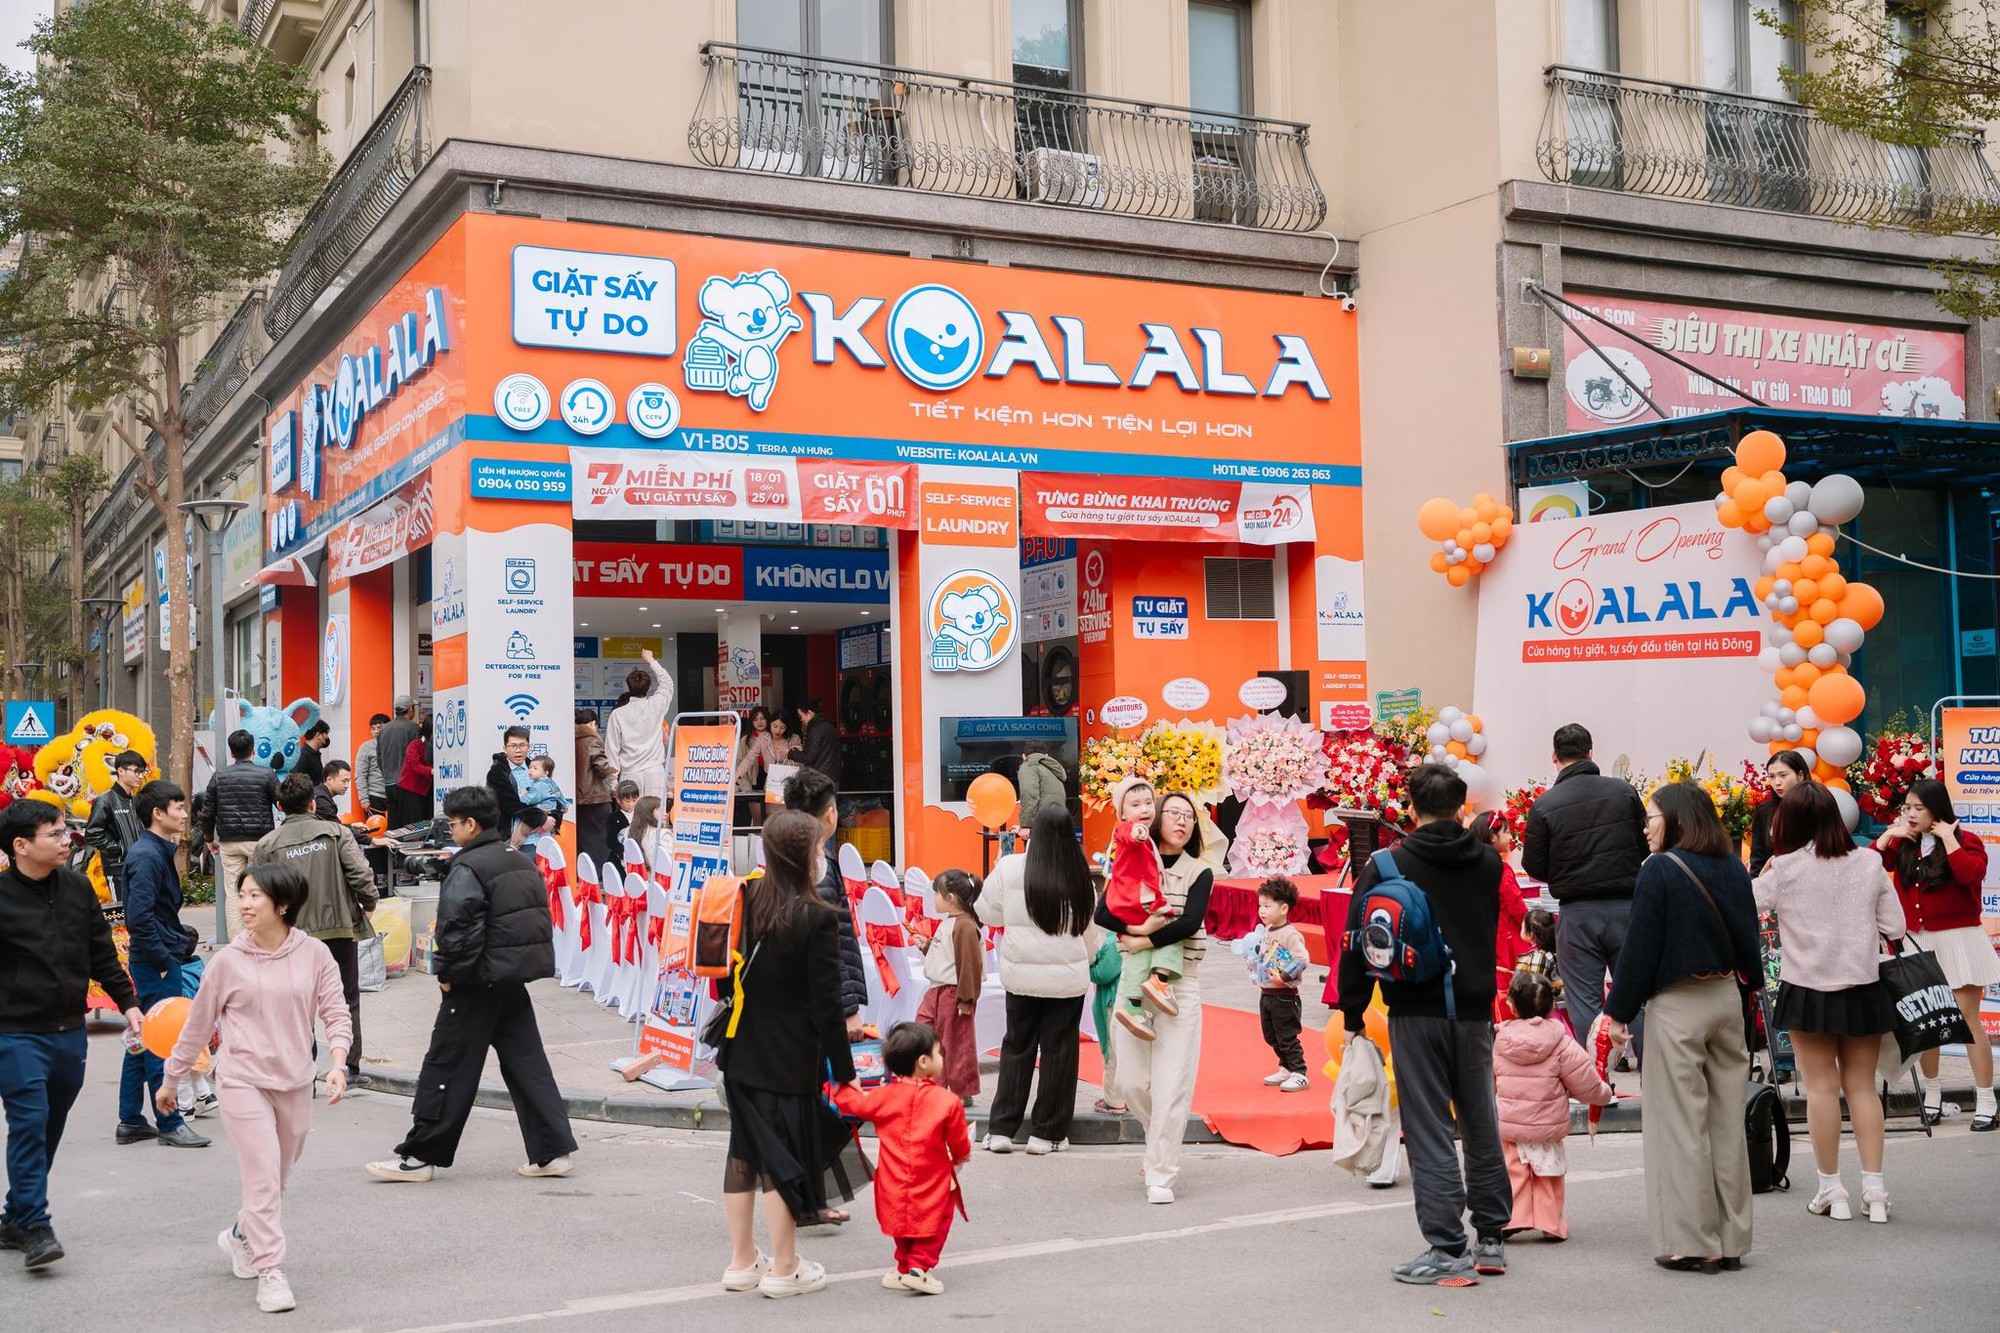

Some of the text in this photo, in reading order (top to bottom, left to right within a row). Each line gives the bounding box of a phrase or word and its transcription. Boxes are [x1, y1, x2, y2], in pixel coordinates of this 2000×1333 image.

[532, 267, 658, 301] GIẶT SẤY
[545, 307, 648, 337] TỰ DO
[1604, 307, 1636, 326] SƠN
[1661, 312, 1910, 378] SIÊU THỊ XE NHẬT CŨ
[1751, 377, 1766, 401] KÝ
[1769, 378, 1790, 402] GỬI
[1800, 384, 1829, 404] TRAO
[1831, 381, 1852, 408] ĐỔI
[514, 406, 532, 414] FREE
[645, 413, 663, 421] CCTV
[909, 398, 965, 420] TIẾT
[1042, 409, 1093, 429] HƠN
[1101, 412, 1153, 435] TIỆN
[1162, 418, 1197, 438] LỢI
[1205, 420, 1253, 439] HƠN
[572, 415, 589, 425] 24h
[681, 432, 750, 451] V1-B05
[756, 443, 788, 454] TERRA
[790, 445, 806, 455] AN
[896, 445, 1039, 465] WEBSITE: KOALALA.VN
[478, 465, 495, 475] LIÊN
[496, 466, 506, 477] HỆ
[626, 463, 733, 489] MIỄN PHÍ
[749, 472, 782, 484] 18/01
[1212, 464, 1331, 480] HOTLINE: 0906 263 863
[478, 477, 567, 492] 0904 050 959
[587, 462, 624, 505] 7
[759, 483, 774, 491] đến
[813, 471, 860, 492] GIẶT
[591, 487, 621, 496] NGÀY
[633, 491, 728, 505] TỰ GIẶT TỰ SẤY
[752, 493, 785, 505] 25/01
[925, 491, 1012, 508] SELF-SERVICE
[823, 491, 863, 513] SẤY
[1036, 490, 1232, 513] TƯNG BỪNG KHAI TRƯƠNG
[886, 507, 907, 518] PHÚT
[1060, 509, 1078, 519] Cửa
[1080, 509, 1104, 522] hàng
[1164, 514, 1201, 525] KOALALA
[1273, 507, 1292, 528] 24
[926, 517, 1010, 537] LAUNDRY
[1553, 517, 1727, 571] Grand Opening
[600, 554, 731, 590] SẤY TỰ DO
[756, 563, 836, 589] KHÔNG
[840, 569, 871, 590] LO
[1082, 589, 1109, 614] 24hr
[1135, 599, 1184, 617] TỰ GIẶT
[1080, 611, 1112, 633] SERVICE
[1137, 618, 1184, 638] TỰ SẤY
[1527, 643, 1545, 657] Cửa
[1546, 642, 1571, 659] hàng
[1573, 643, 1584, 658] tự
[1609, 641, 1620, 656] tự
[1621, 640, 1638, 656] sấy
[1640, 638, 1662, 654] đầu
[1664, 639, 1685, 653] tiên
[1687, 639, 1702, 653] tại
[1704, 637, 1720, 651] Hà
[1722, 636, 1753, 653] Đông
[485, 663, 526, 671] DETERGENT,
[729, 686, 760, 703] STOP
[1960, 748, 2000, 765] KHA
[285, 842, 327, 859] HALCYON
[678, 862, 687, 891] 7
